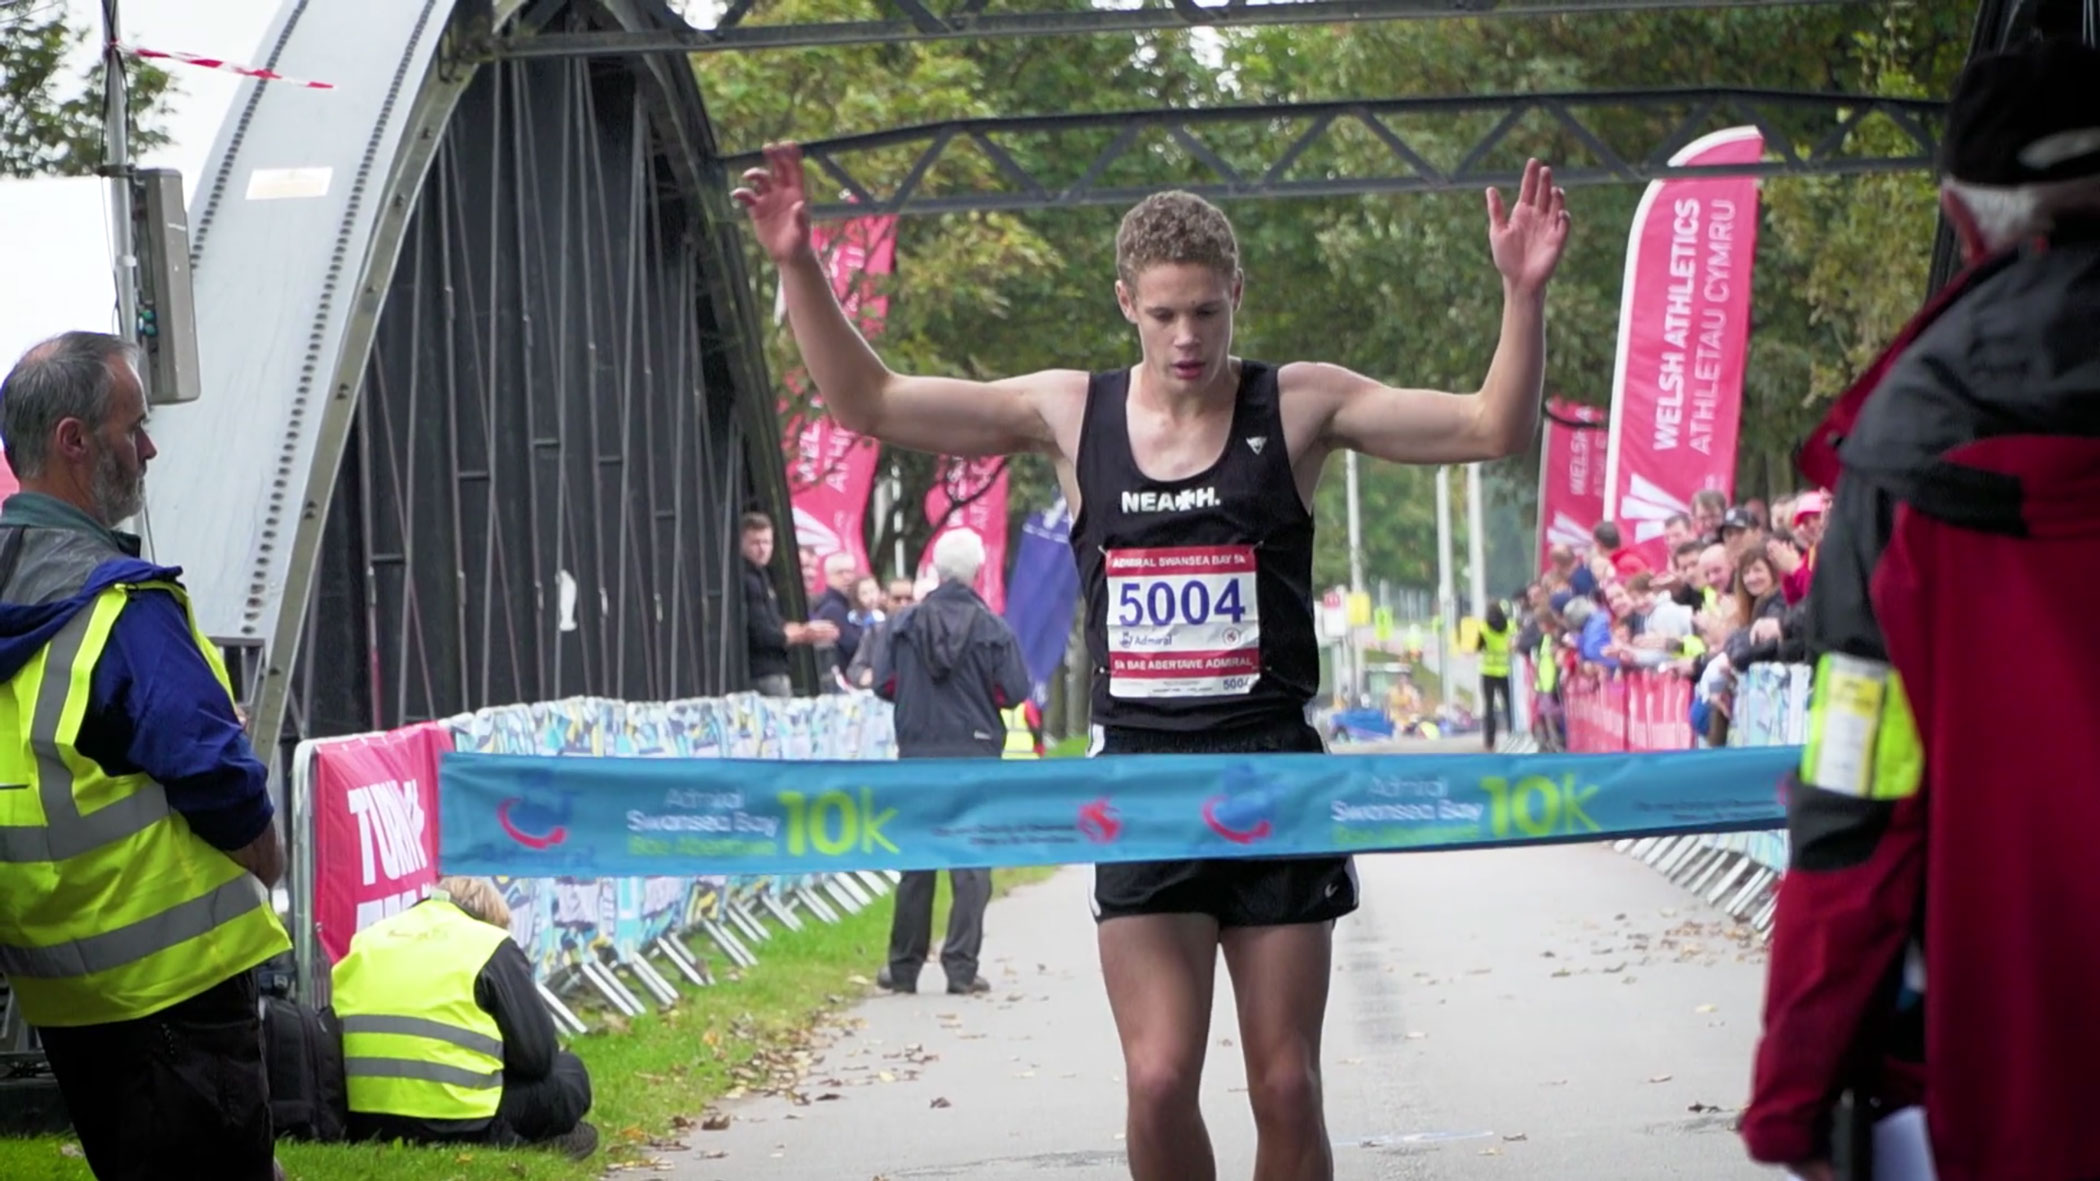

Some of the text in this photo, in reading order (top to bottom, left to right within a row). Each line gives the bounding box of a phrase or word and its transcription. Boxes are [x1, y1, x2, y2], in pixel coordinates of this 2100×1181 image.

[1703, 199, 1737, 301] CYMRU
[1653, 198, 1699, 450] WELSH ATHLETICS
[1689, 309, 1727, 455] ATHLETAU
[1112, 557, 1156, 569] ADMIRAL
[1159, 555, 1209, 567] SWANSEA
[1212, 554, 1231, 566] BAY
[1118, 578, 1246, 627] 5004
[1127, 660, 1146, 670] BAE
[1149, 659, 1202, 670] ABERTAWE
[1205, 657, 1252, 668] ADMIRAL
[1134, 635, 1173, 646] Admiral
[626, 809, 731, 832] Swansea
[777, 786, 901, 856] 10k
[1479, 772, 1602, 838] 10k
